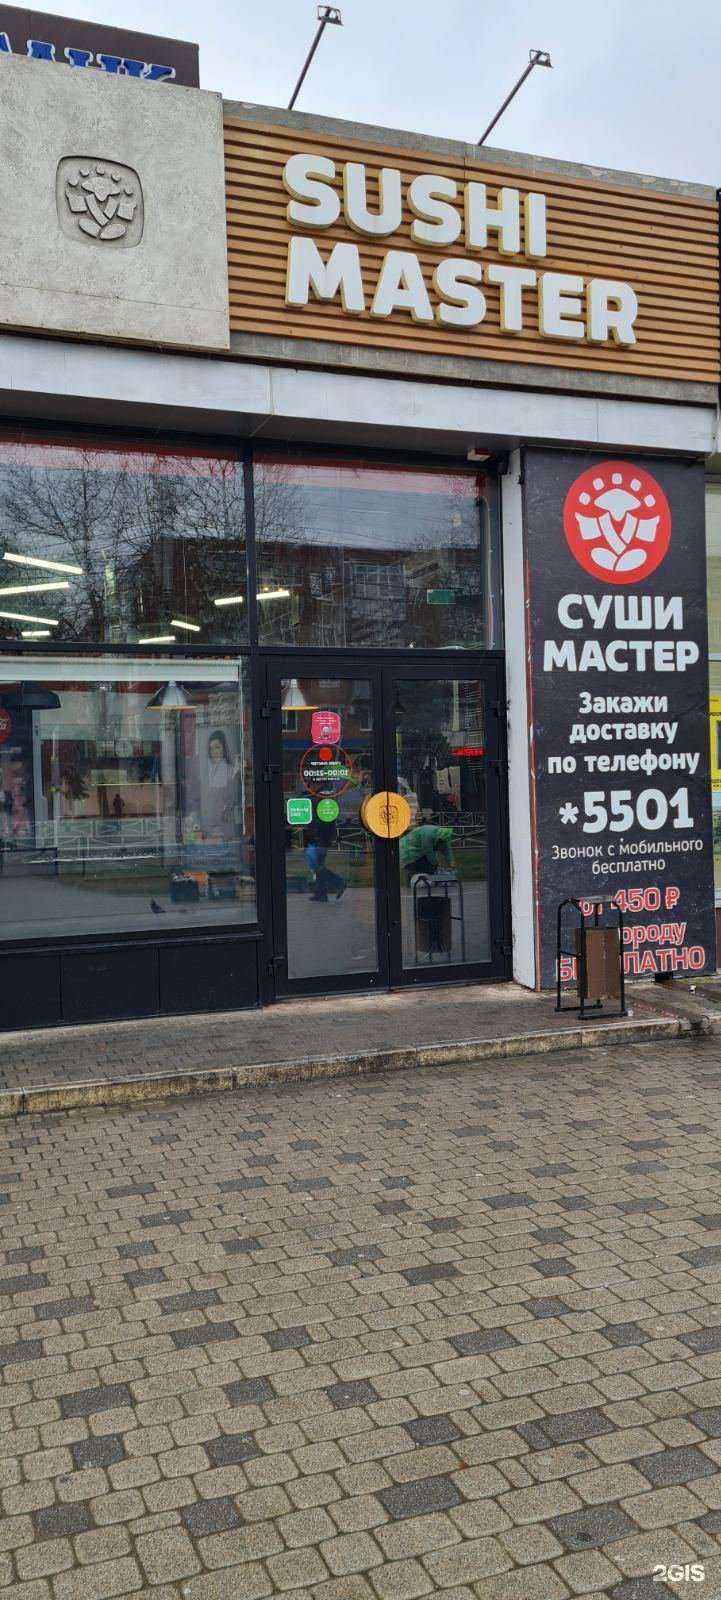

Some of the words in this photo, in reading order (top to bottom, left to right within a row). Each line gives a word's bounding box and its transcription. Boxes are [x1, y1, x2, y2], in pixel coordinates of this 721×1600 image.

[283, 153, 548, 259] SUSHI
[285, 236, 638, 346] MASTER
[557, 593, 684, 630] СУШИ
[543, 639, 700, 672] МАСТЕР
[578, 691, 669, 714] Закажи
[569, 721, 679, 744] доставку
[547, 756, 577, 774] по
[584, 748, 700, 776] телефону
[551, 844, 604, 860] Звонок
[607, 845, 616, 856] с
[619, 838, 704, 855] мобильного
[591, 859, 666, 875] бесплатно
[611, 886, 661, 913] 450
[617, 922, 688, 950] ороду
